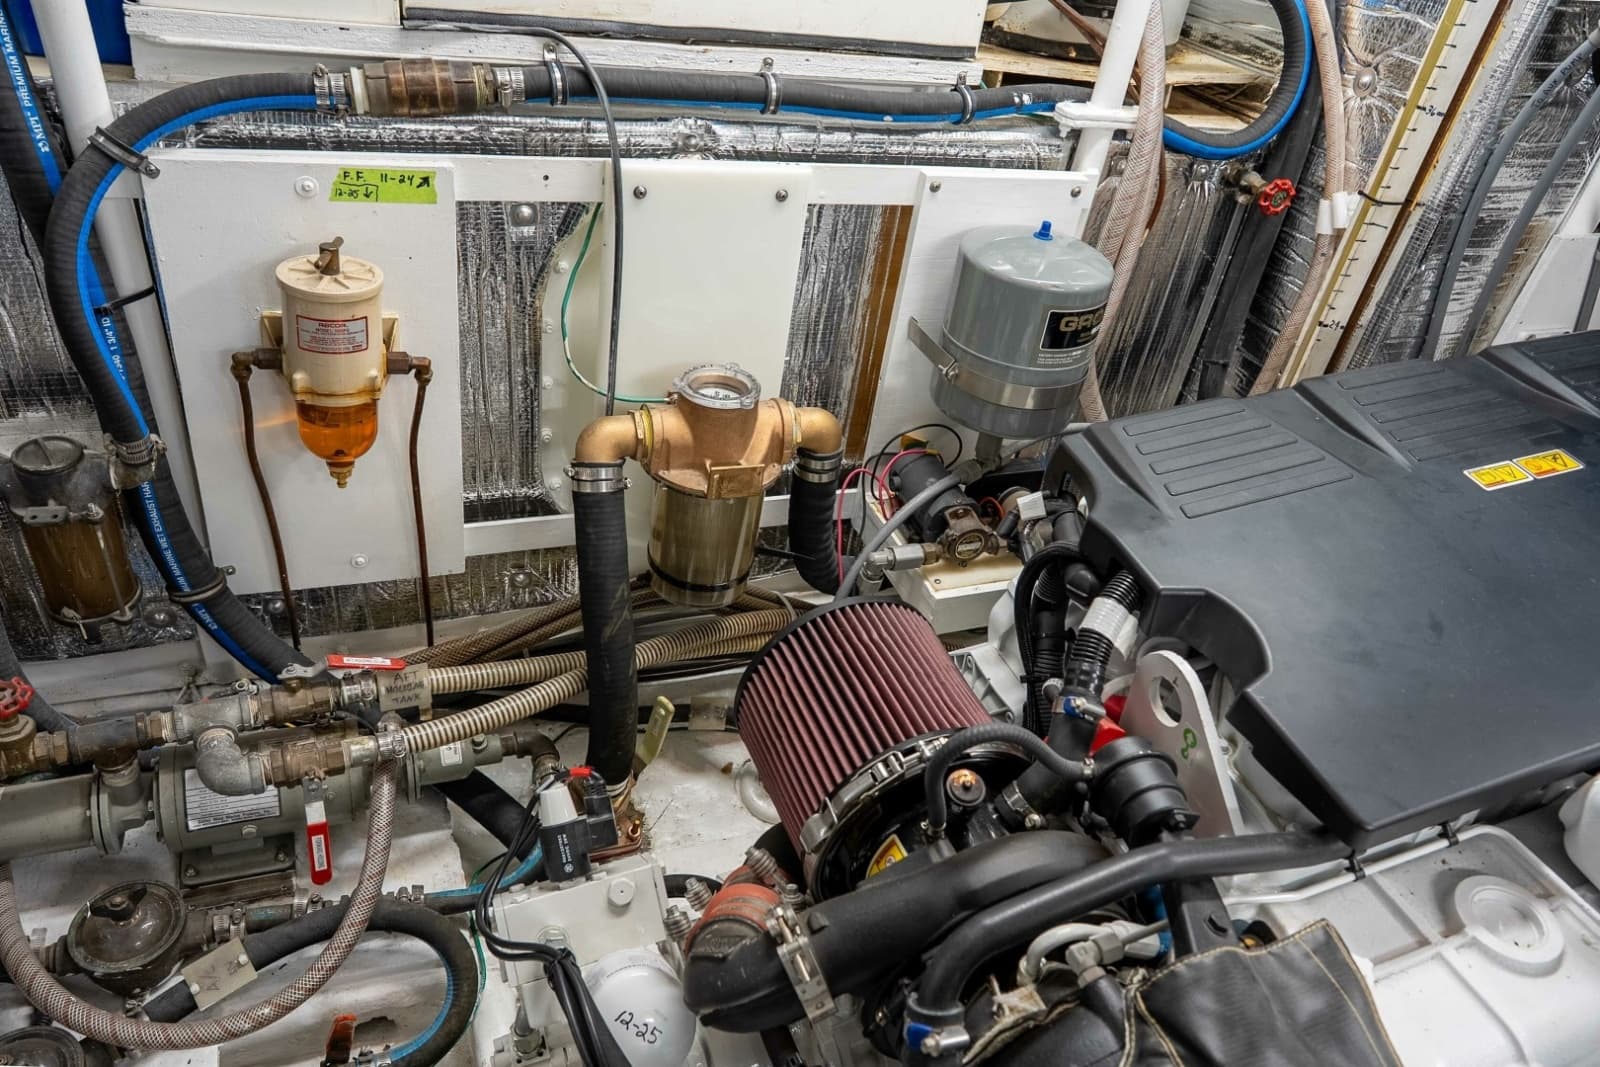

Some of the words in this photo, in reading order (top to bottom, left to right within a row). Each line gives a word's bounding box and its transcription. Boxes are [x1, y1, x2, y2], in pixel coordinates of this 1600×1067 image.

[11, 56, 32, 107] PREMIUM
[380, 172, 414, 186] 11-24
[147, 499, 163, 533] EXHAUST
[393, 671, 418, 684] AFT
[614, 1010, 663, 1044] 12-25
